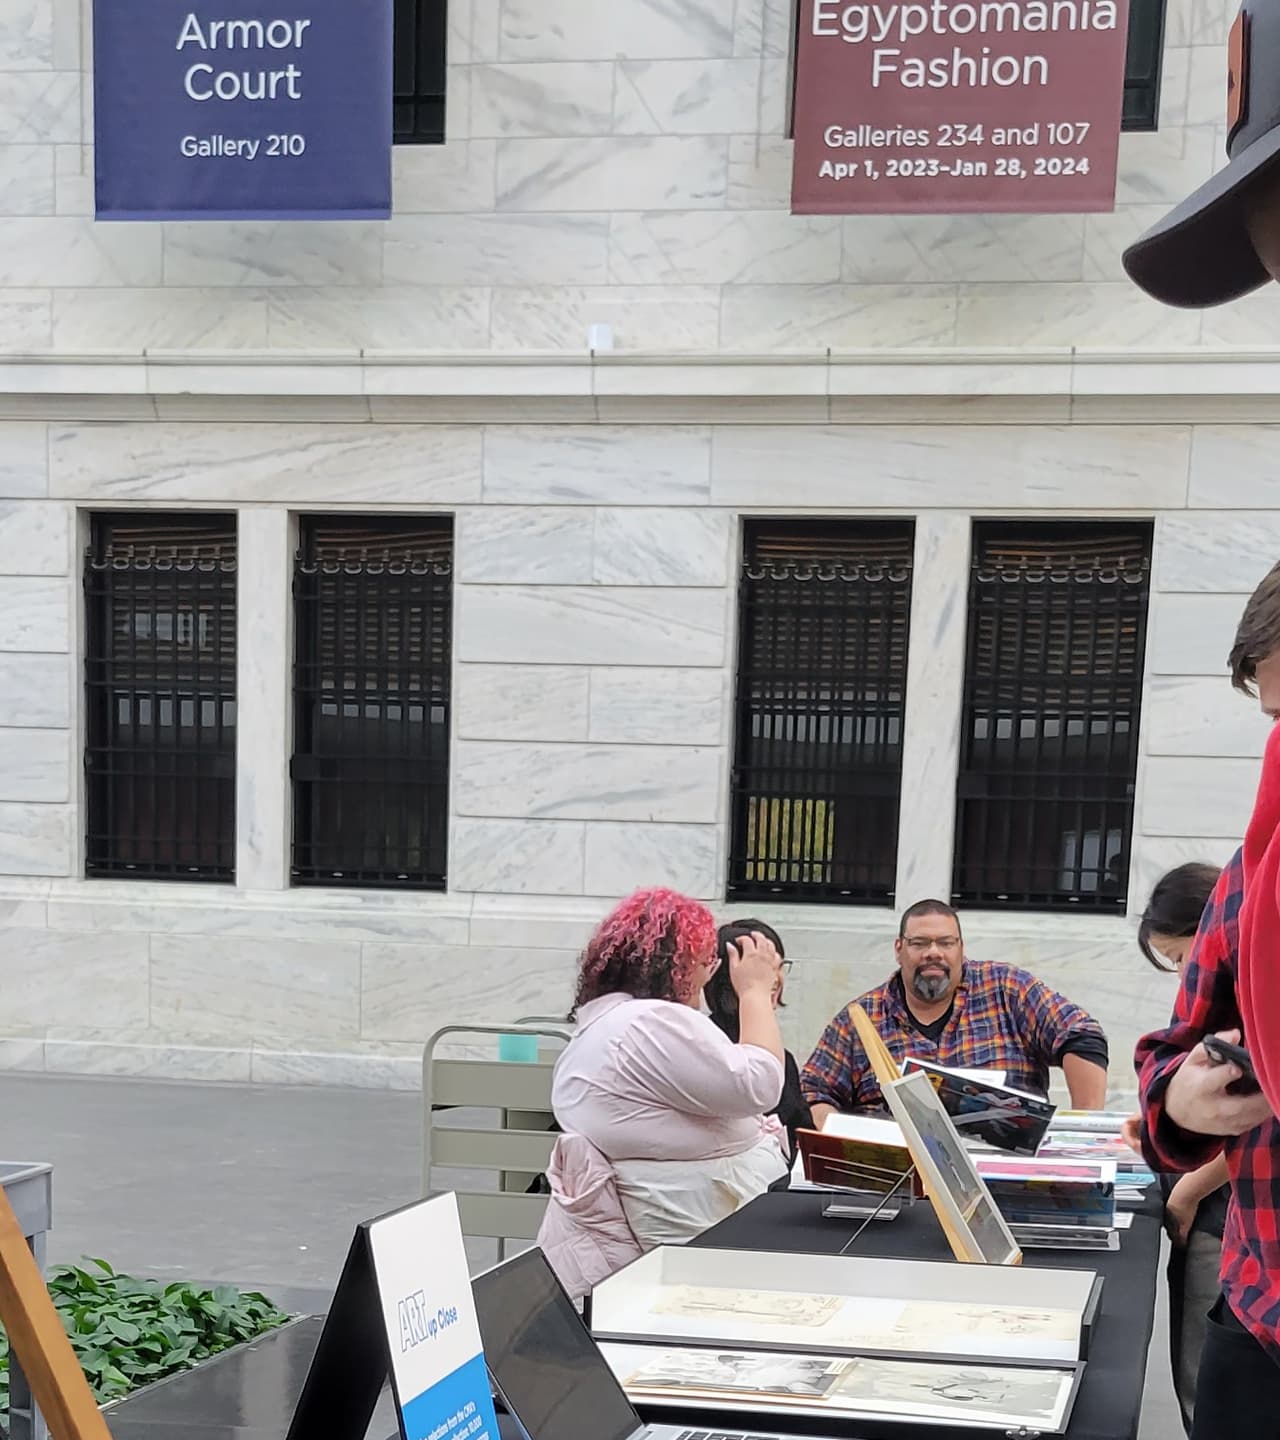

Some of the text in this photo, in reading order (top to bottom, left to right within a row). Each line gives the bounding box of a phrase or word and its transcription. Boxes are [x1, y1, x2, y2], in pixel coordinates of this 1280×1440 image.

[175, 13, 311, 50] Armor
[811, 0, 1118, 43] Egyptomania
[184, 63, 302, 100] Court
[871, 47, 1049, 88] Fashion
[180, 134, 306, 160] Gallery 210
[824, 122, 1091, 148] Galleries 234 and 107
[818, 160, 858, 181] Apr
[863, 160, 881, 181] 1,
[994, 158, 1028, 180] 28,
[1033, 157, 1091, 176] 2024
[396, 1289, 459, 1352] ART up Close
